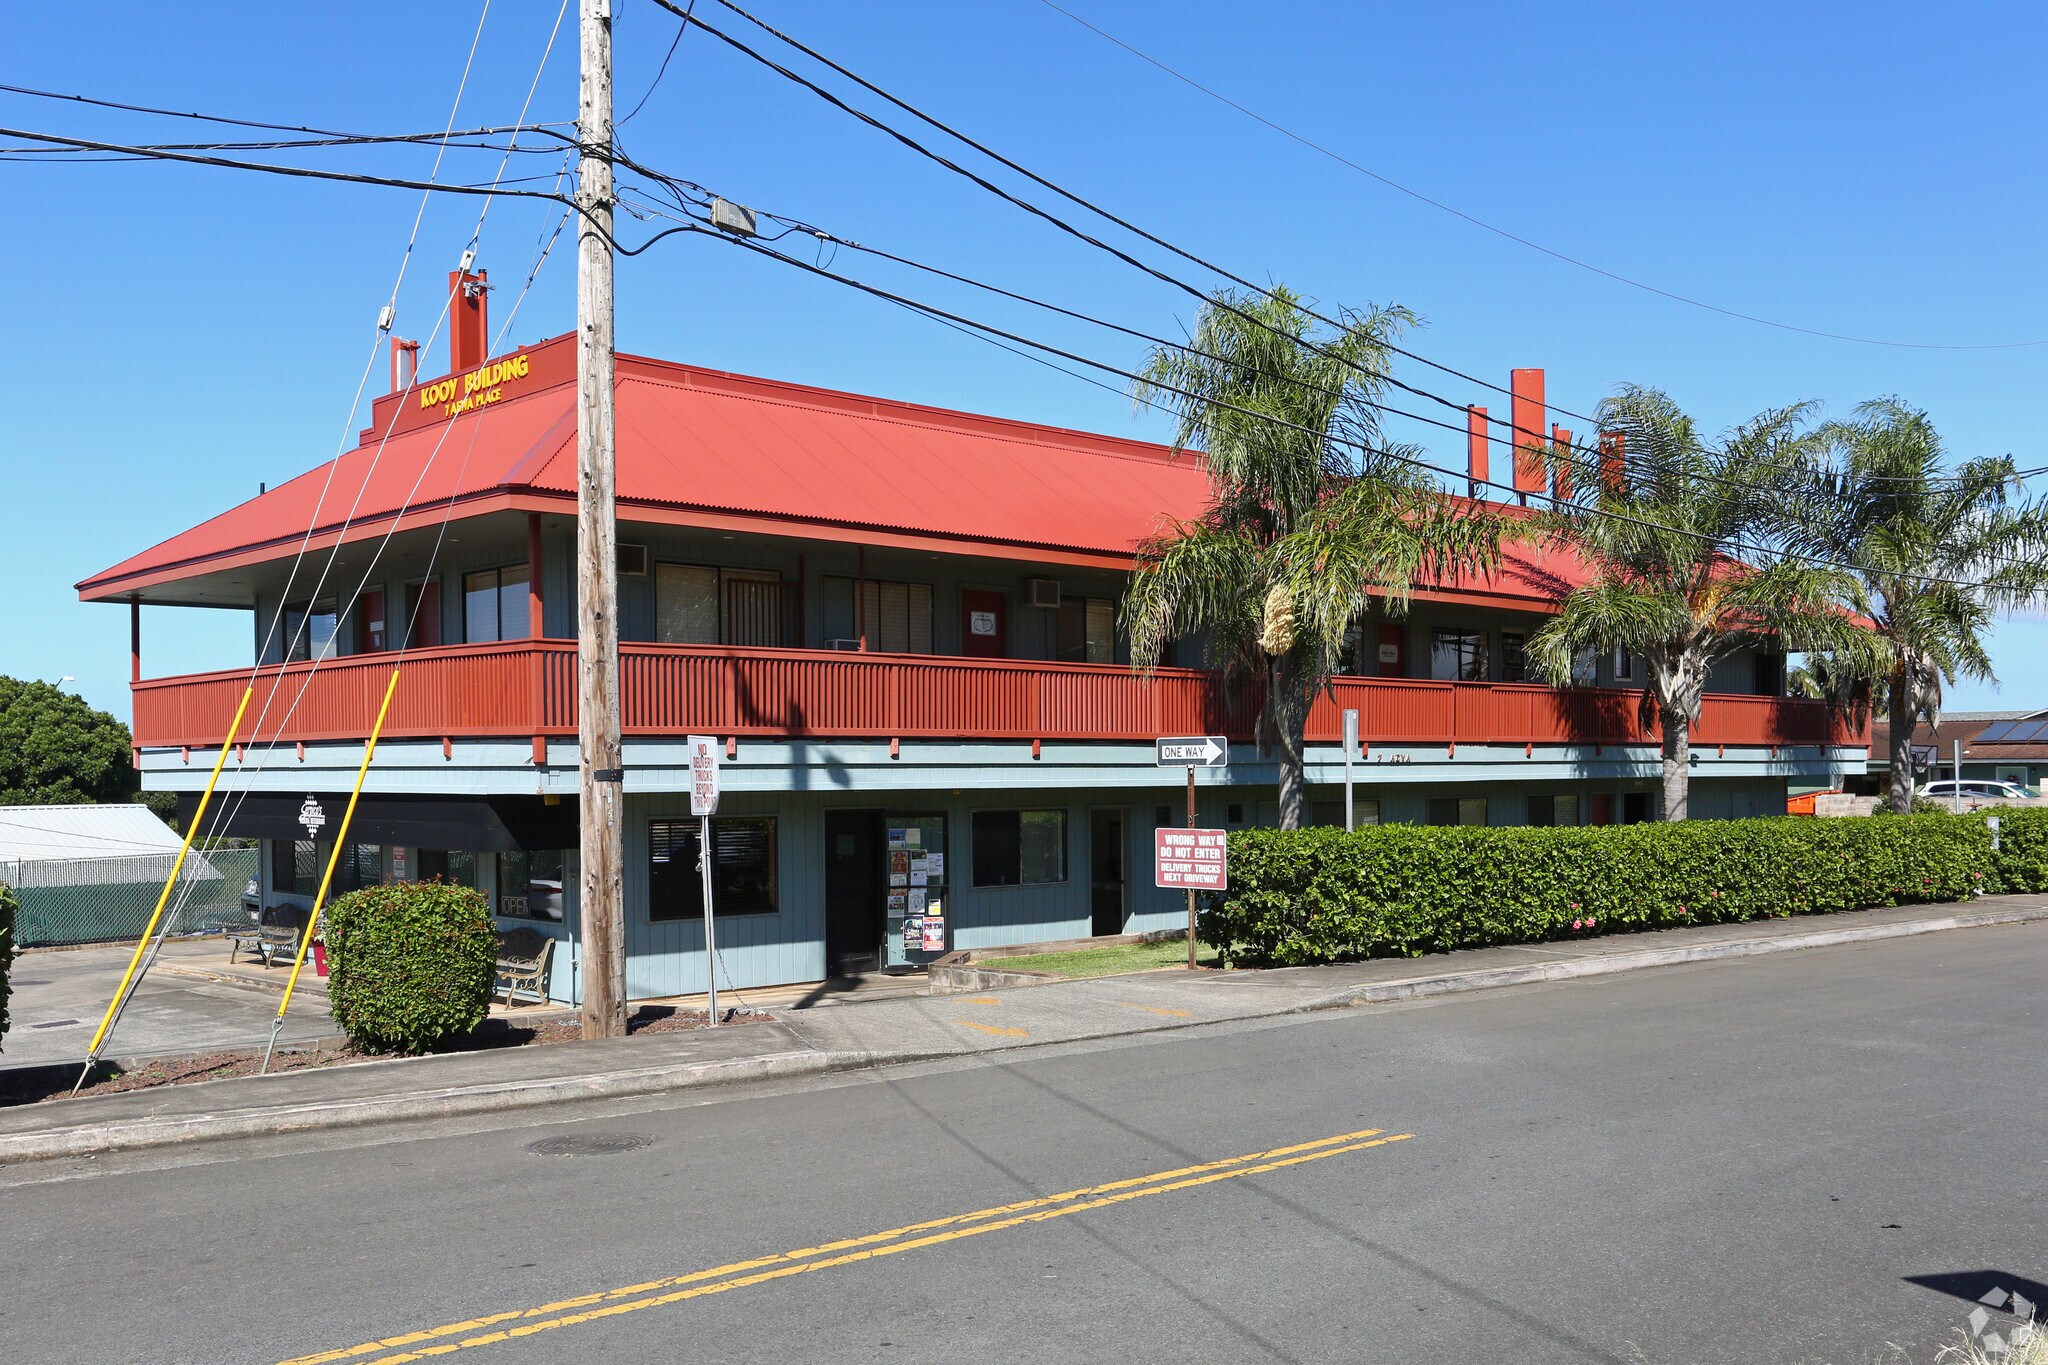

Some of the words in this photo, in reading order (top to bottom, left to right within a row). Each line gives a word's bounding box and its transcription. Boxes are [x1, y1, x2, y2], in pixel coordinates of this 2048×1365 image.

[420, 377, 458, 409] KOOY
[464, 355, 529, 394] BUILDING
[476, 388, 501, 407] PLACE
[698, 743, 707, 755] NO
[1164, 747, 1182, 757] ONE
[1185, 747, 1205, 757] WAY
[693, 756, 713, 768] DELIVERY
[695, 770, 713, 782] TRUCKS
[696, 783, 713, 795] BEYOND
[694, 796, 703, 808] THIS
[1165, 834, 1195, 846] WRONG
[1198, 835, 1216, 846] WAY
[1160, 846, 1172, 857] DO
[1175, 847, 1192, 858] NOT
[1194, 848, 1220, 859] ENTER
[1161, 863, 1192, 873] DELIVERY
[1195, 864, 1221, 874] TRUCKS
[1163, 872, 1182, 882] NEXT
[1184, 873, 1219, 884] DRIVEWAY
[503, 898, 528, 915] OPEN
